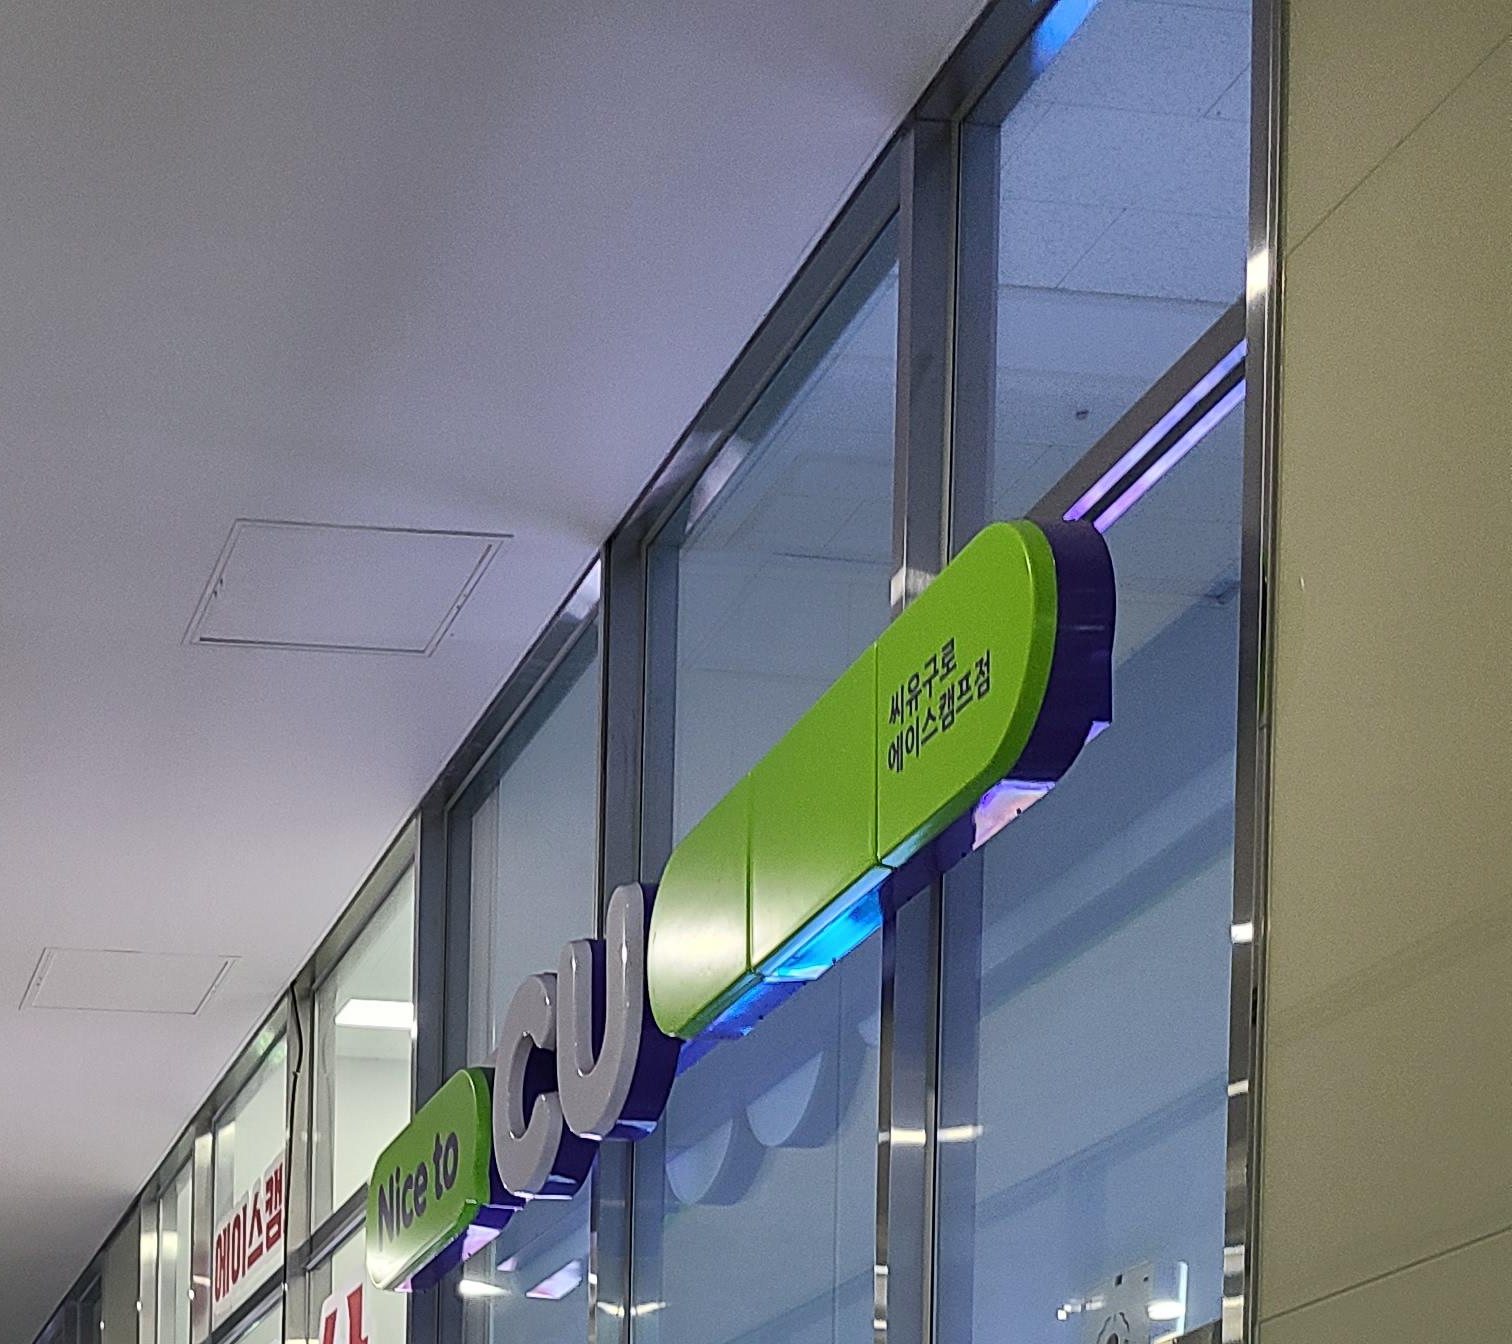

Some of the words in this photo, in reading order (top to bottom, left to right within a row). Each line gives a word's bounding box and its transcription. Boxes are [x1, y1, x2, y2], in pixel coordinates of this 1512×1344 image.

[888, 648, 991, 774] 에이스캠프점
[889, 637, 957, 725] 씨유구로
[376, 1160, 429, 1253] Nice
[432, 1131, 460, 1201] to
[493, 881, 645, 1200] CU
